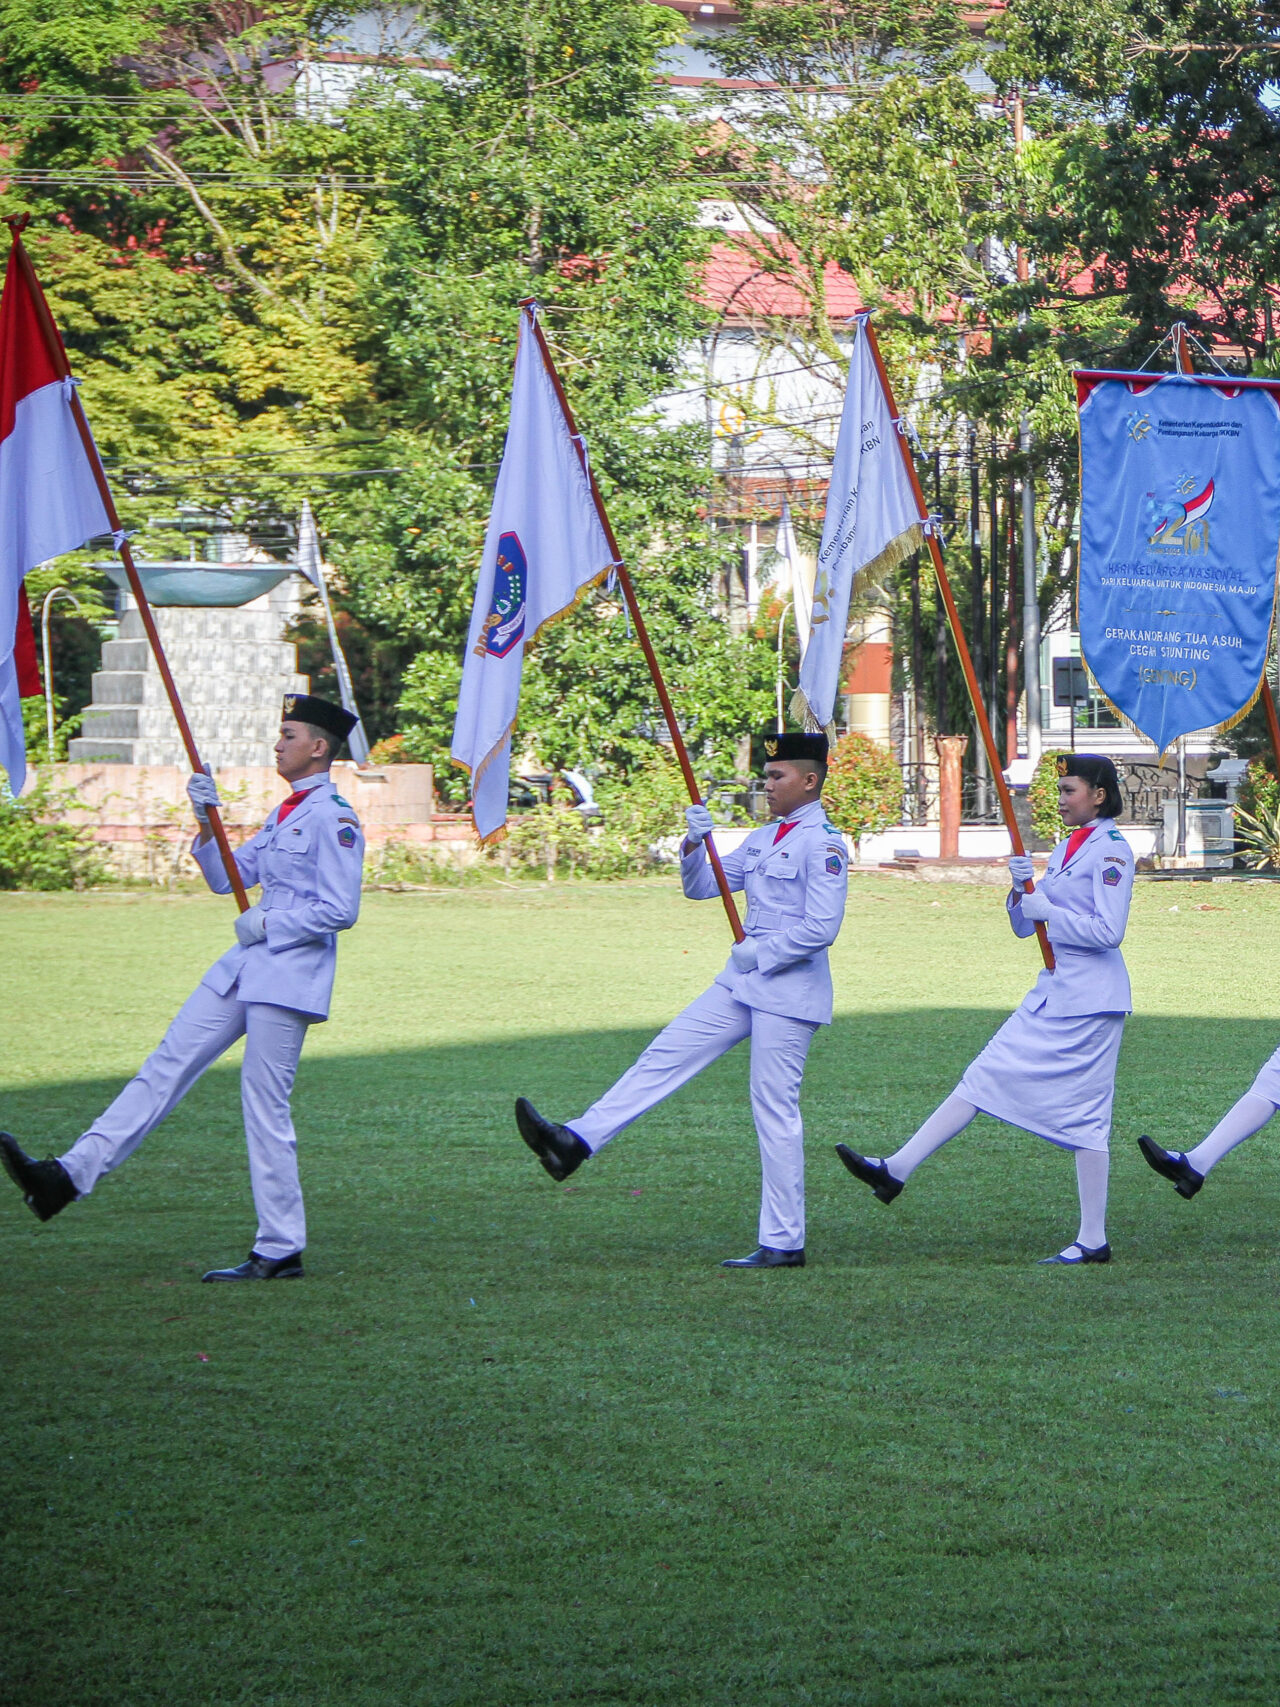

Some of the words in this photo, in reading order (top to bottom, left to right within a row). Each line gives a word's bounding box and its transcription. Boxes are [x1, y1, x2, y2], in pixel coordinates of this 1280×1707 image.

[1116, 577, 1155, 588] KELUARGA
[1228, 585, 1258, 595] MAJU
[1105, 627, 1152, 641] GERAKAN
[1185, 632, 1209, 645] TUA
[1211, 635, 1242, 649] ASUH
